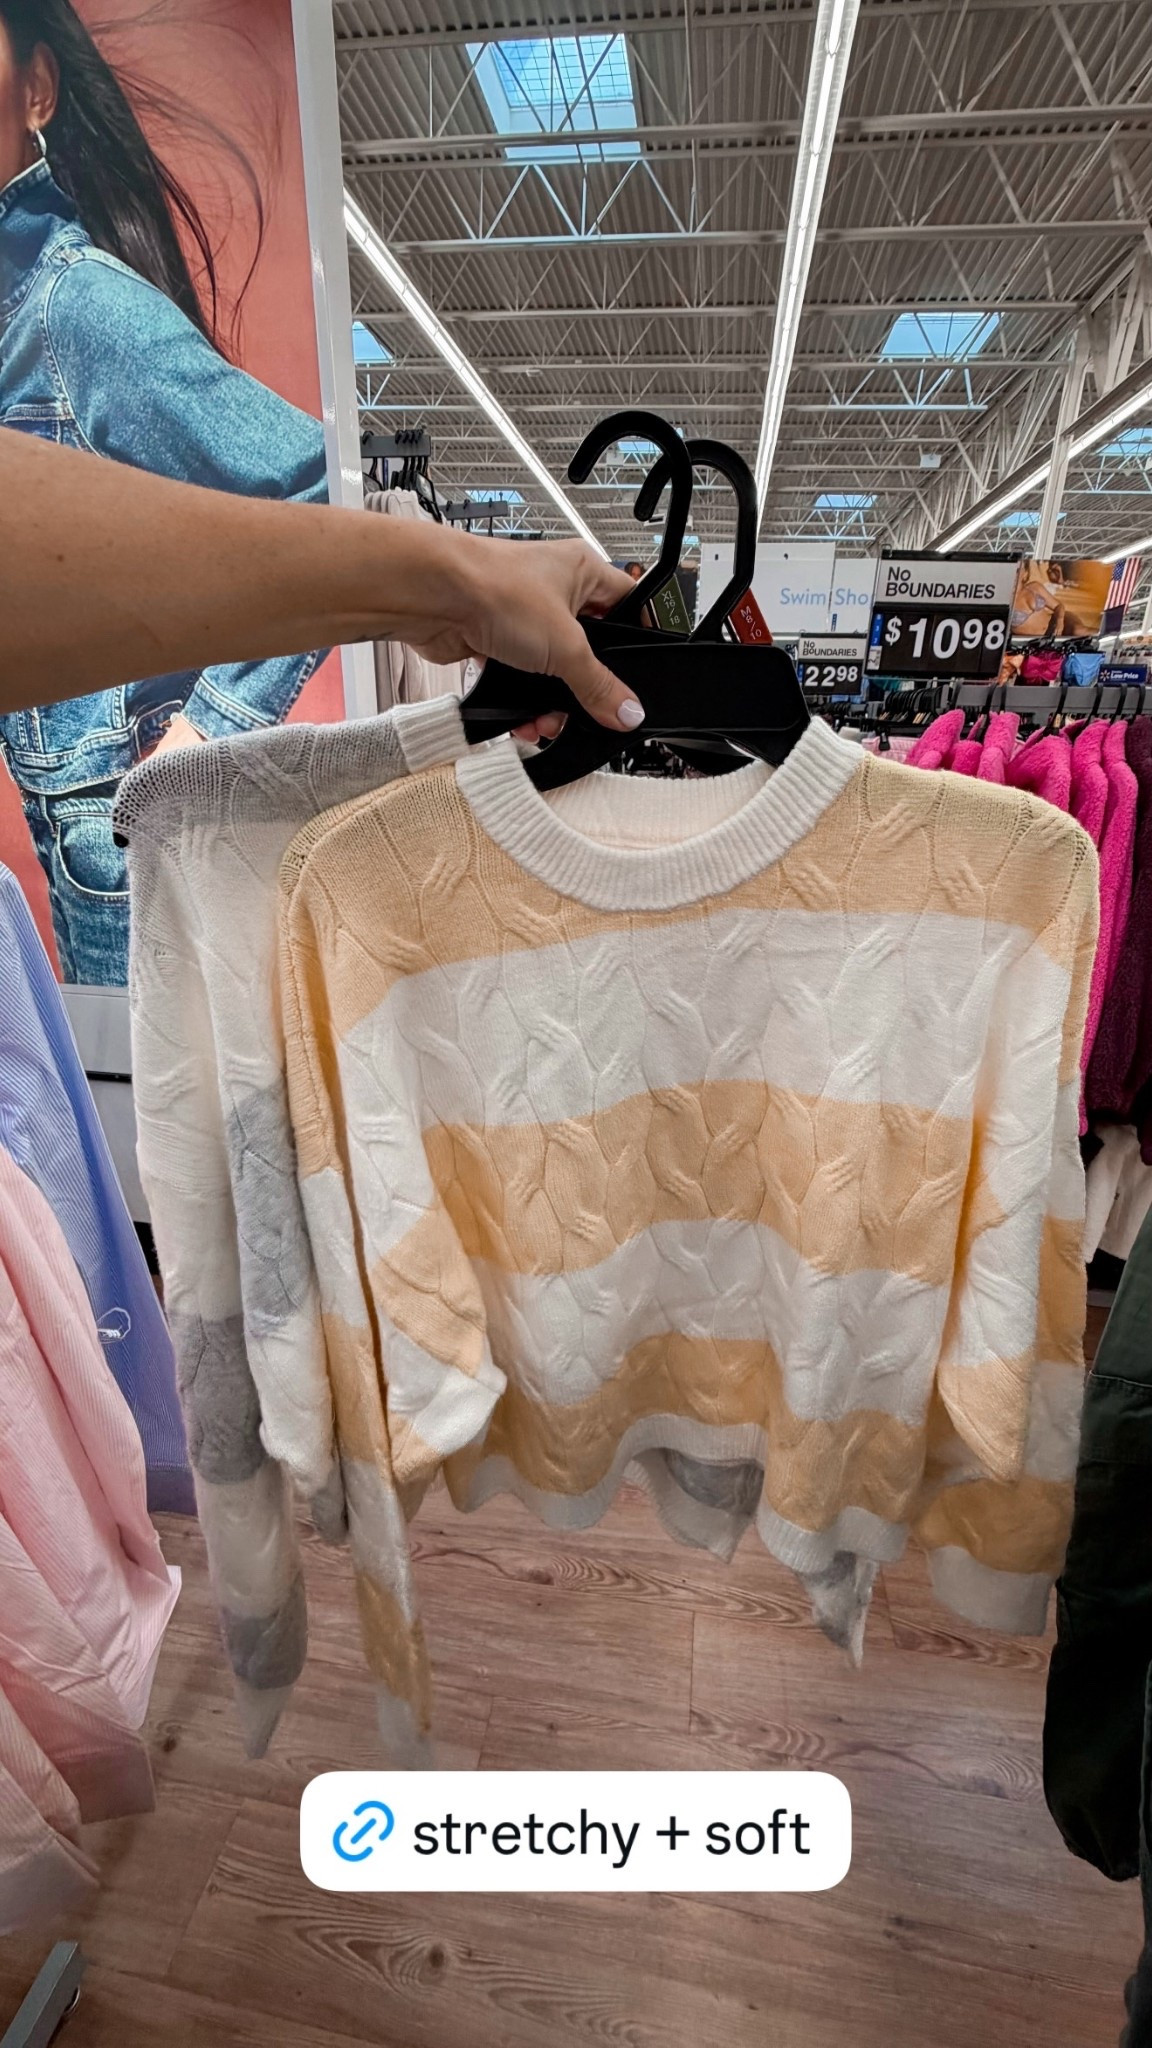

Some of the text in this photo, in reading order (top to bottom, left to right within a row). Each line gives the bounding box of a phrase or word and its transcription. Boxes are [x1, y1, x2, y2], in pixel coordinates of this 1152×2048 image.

[661, 590, 677, 601] XL
[780, 587, 874, 606] Swim Sho
[740, 605, 752, 618] M
